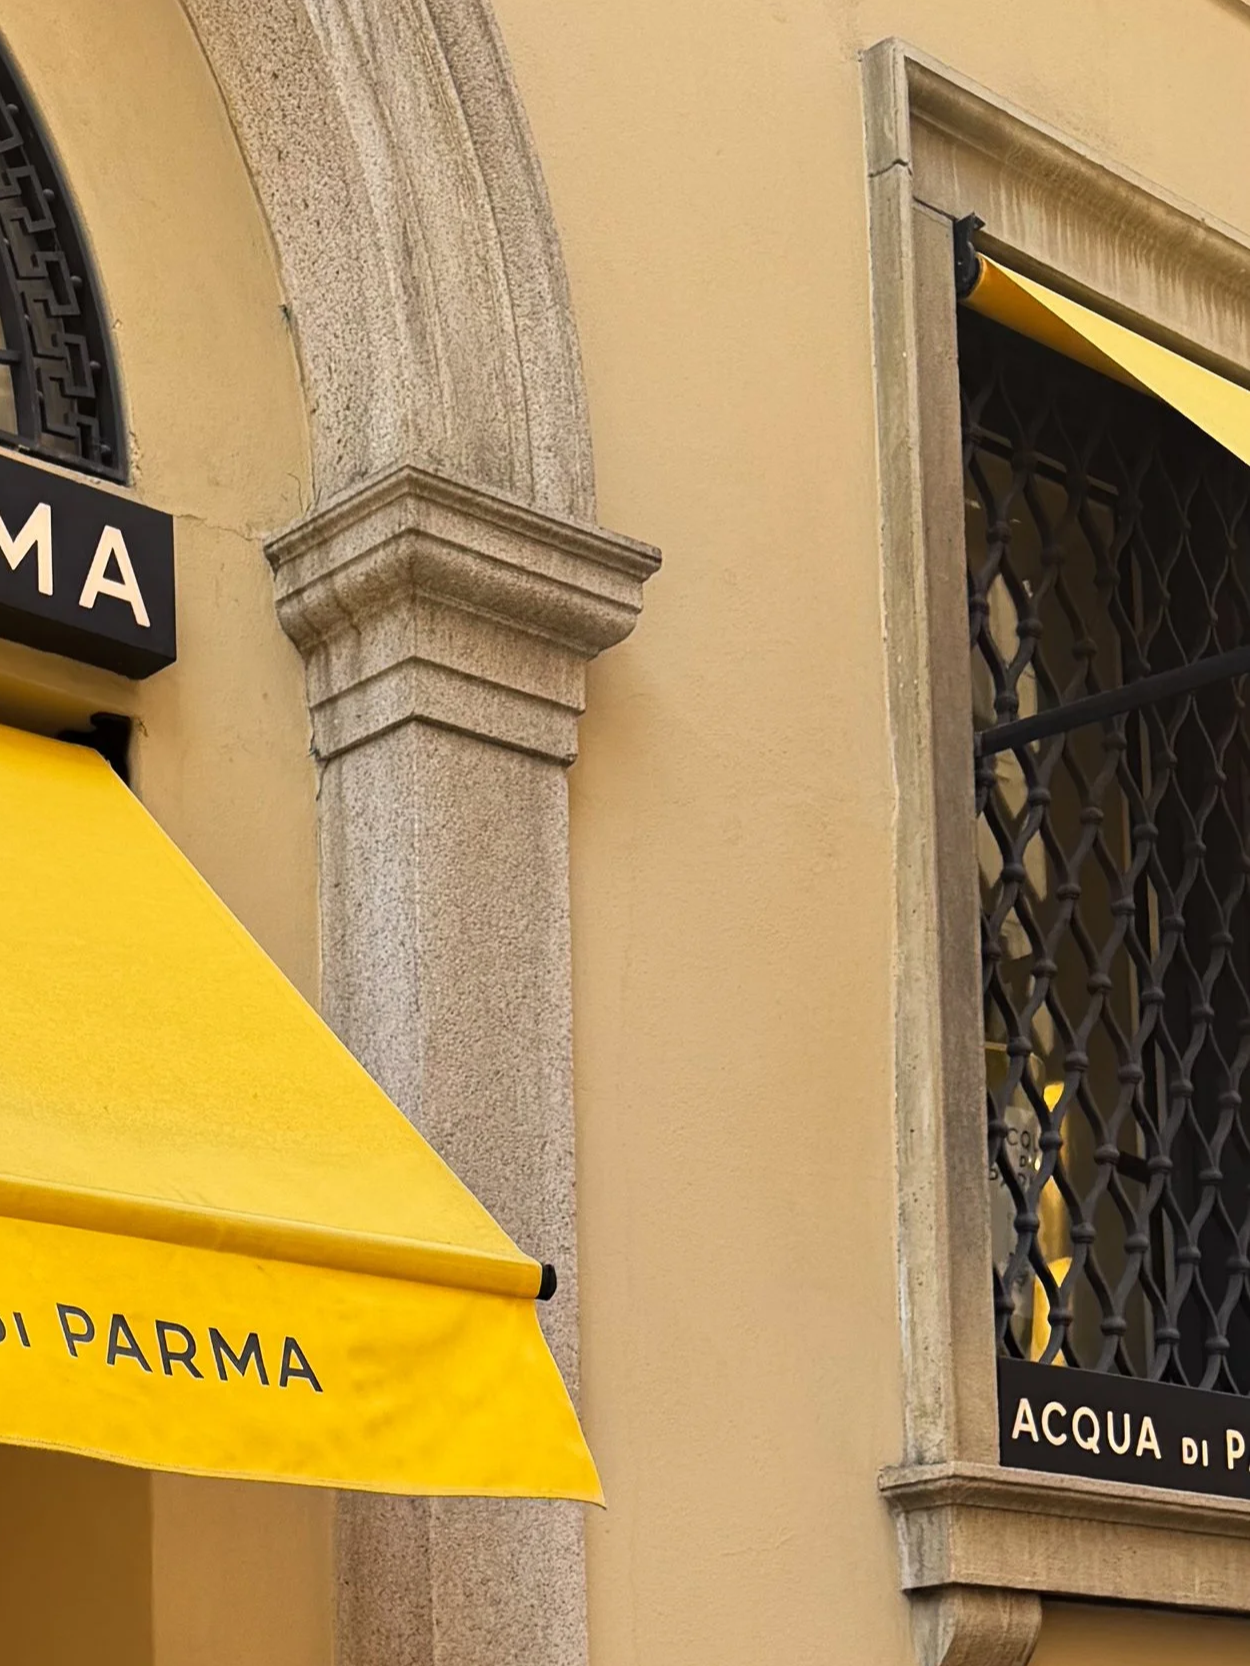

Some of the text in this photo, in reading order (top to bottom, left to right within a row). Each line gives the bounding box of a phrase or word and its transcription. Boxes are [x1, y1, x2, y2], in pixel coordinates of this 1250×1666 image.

[56, 1302, 324, 1393] PARMA
[1011, 1397, 1250, 1473] ACQUA DI P
